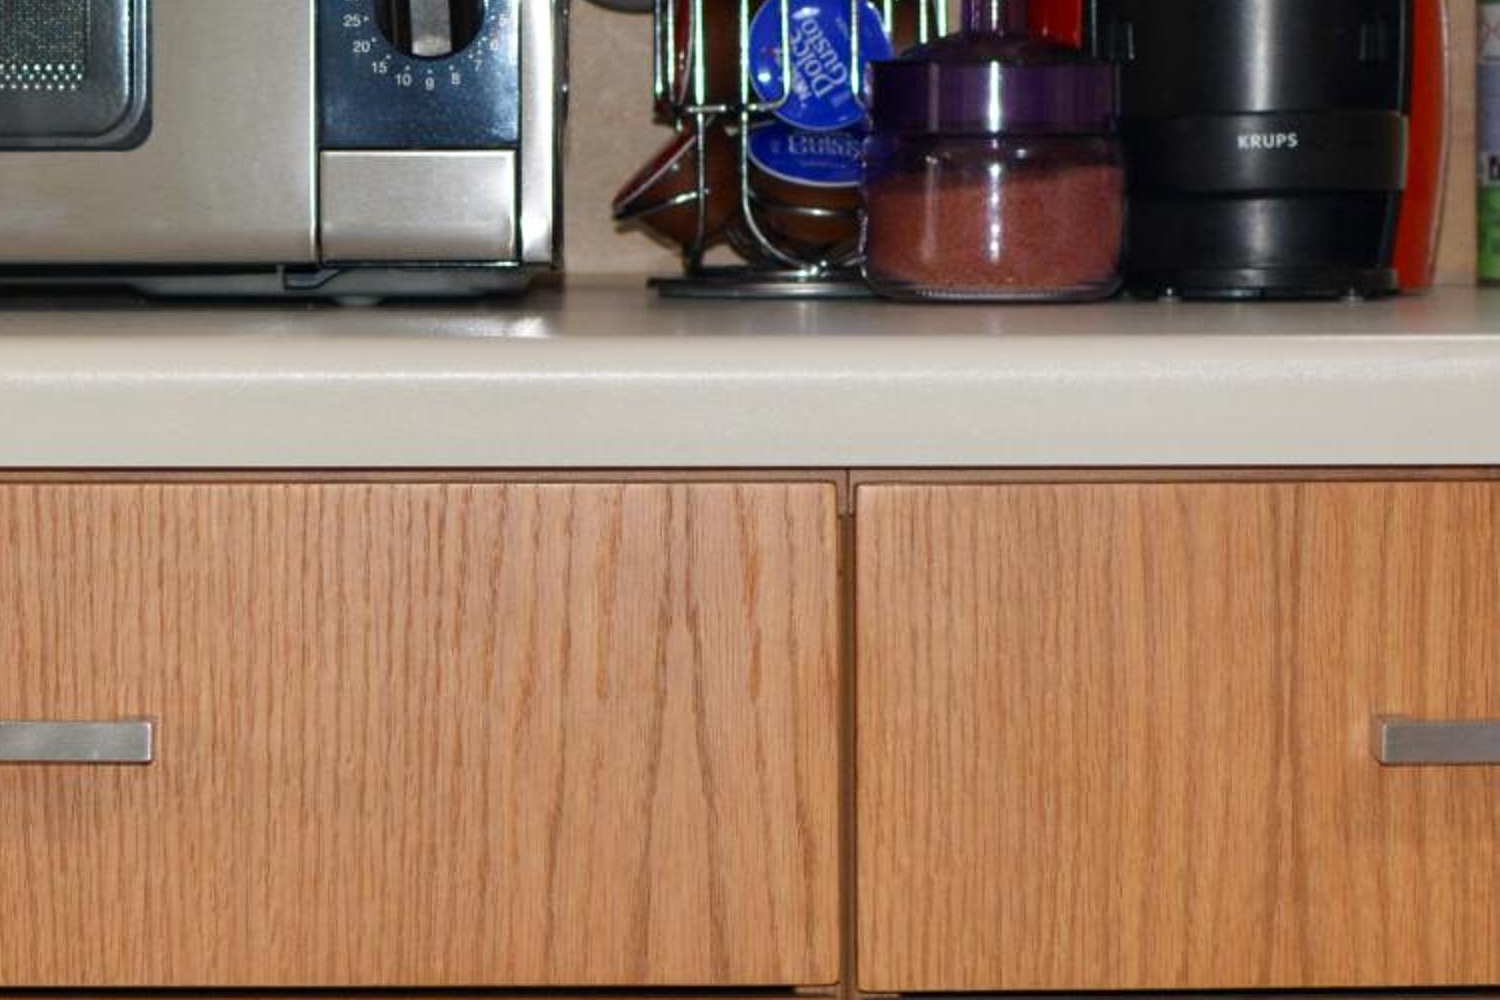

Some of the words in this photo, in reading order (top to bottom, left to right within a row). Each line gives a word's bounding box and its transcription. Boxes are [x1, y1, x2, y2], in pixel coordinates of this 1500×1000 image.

[343, 14, 361, 27] 25
[353, 41, 370, 53] 20
[802, 18, 848, 88] Gusto
[371, 62, 388, 74] 15
[474, 59, 484, 72] 7
[395, 74, 412, 87] 10
[425, 77, 435, 90] 9
[1237, 133, 1298, 149] KRUPS
